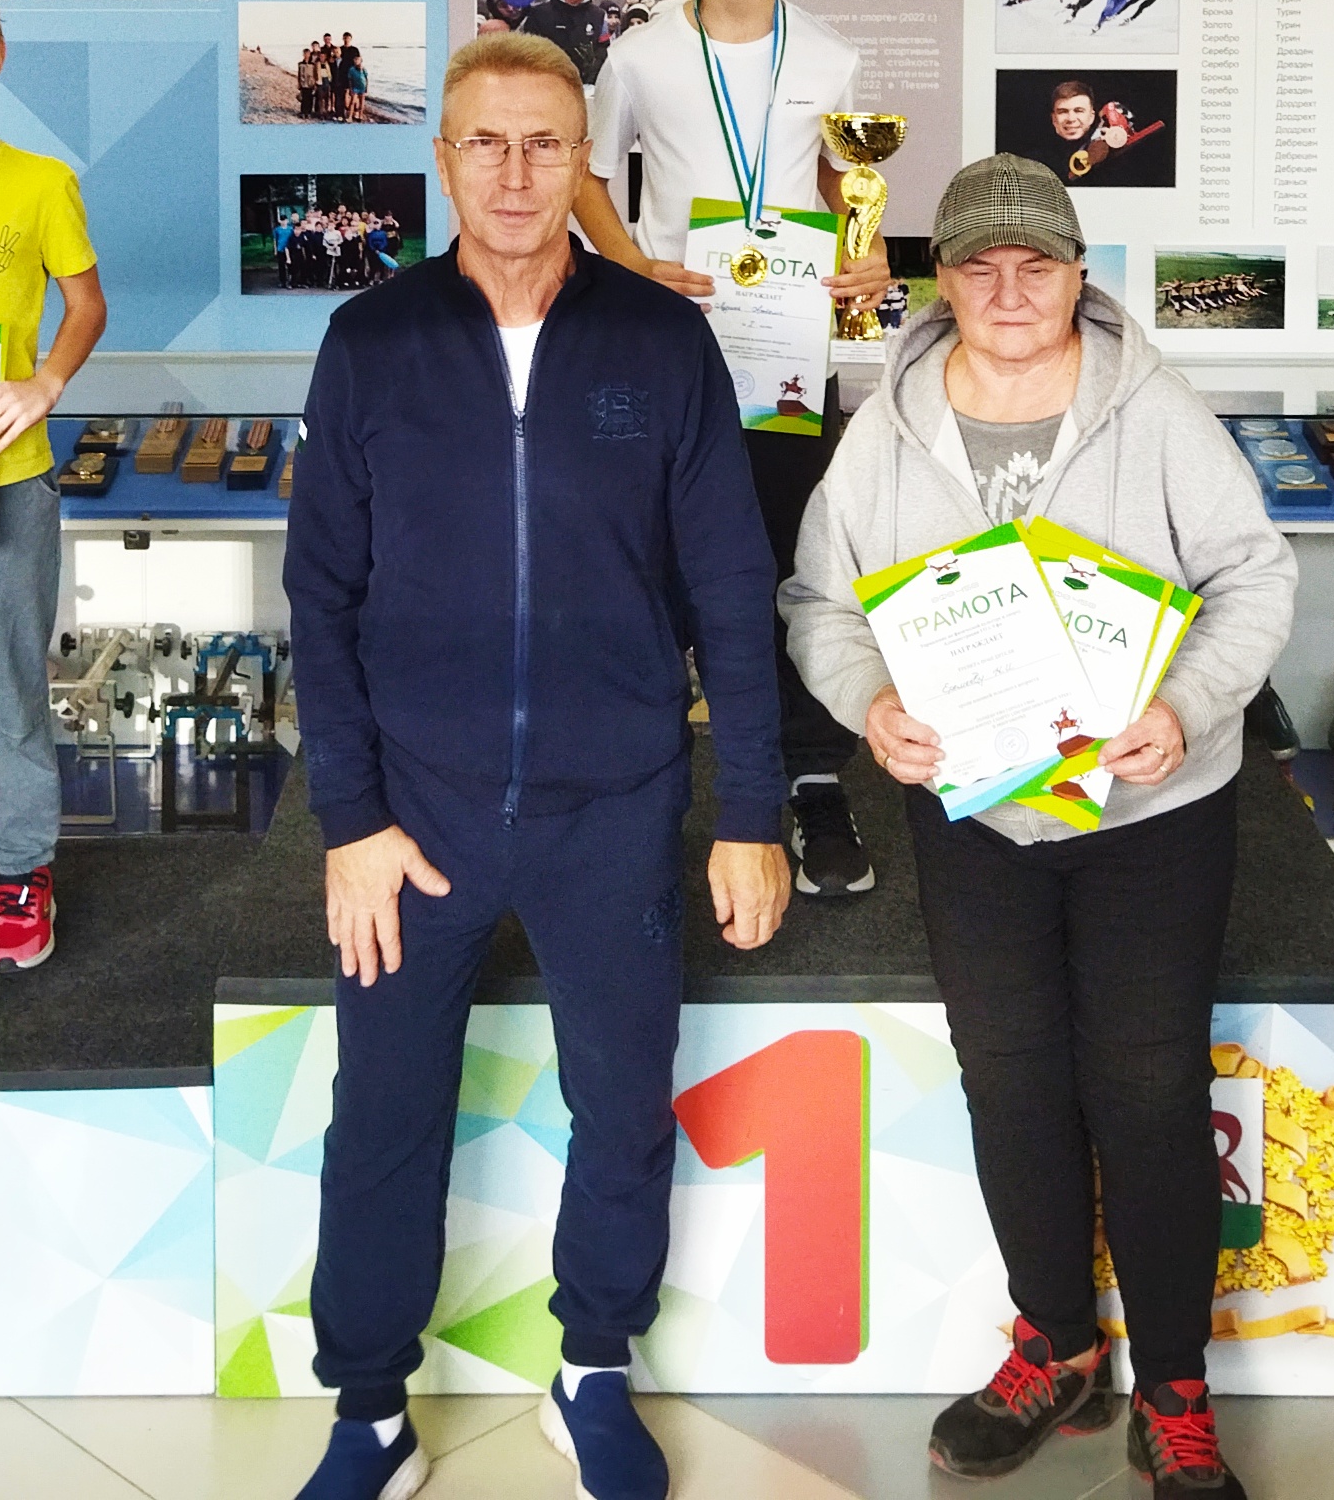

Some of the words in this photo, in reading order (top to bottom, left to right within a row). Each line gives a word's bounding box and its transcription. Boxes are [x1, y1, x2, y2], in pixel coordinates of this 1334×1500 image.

[706, 251, 817, 279] ГРОТА
[898, 583, 1028, 642] ГРАМОТА
[673, 1029, 870, 1365] 1
